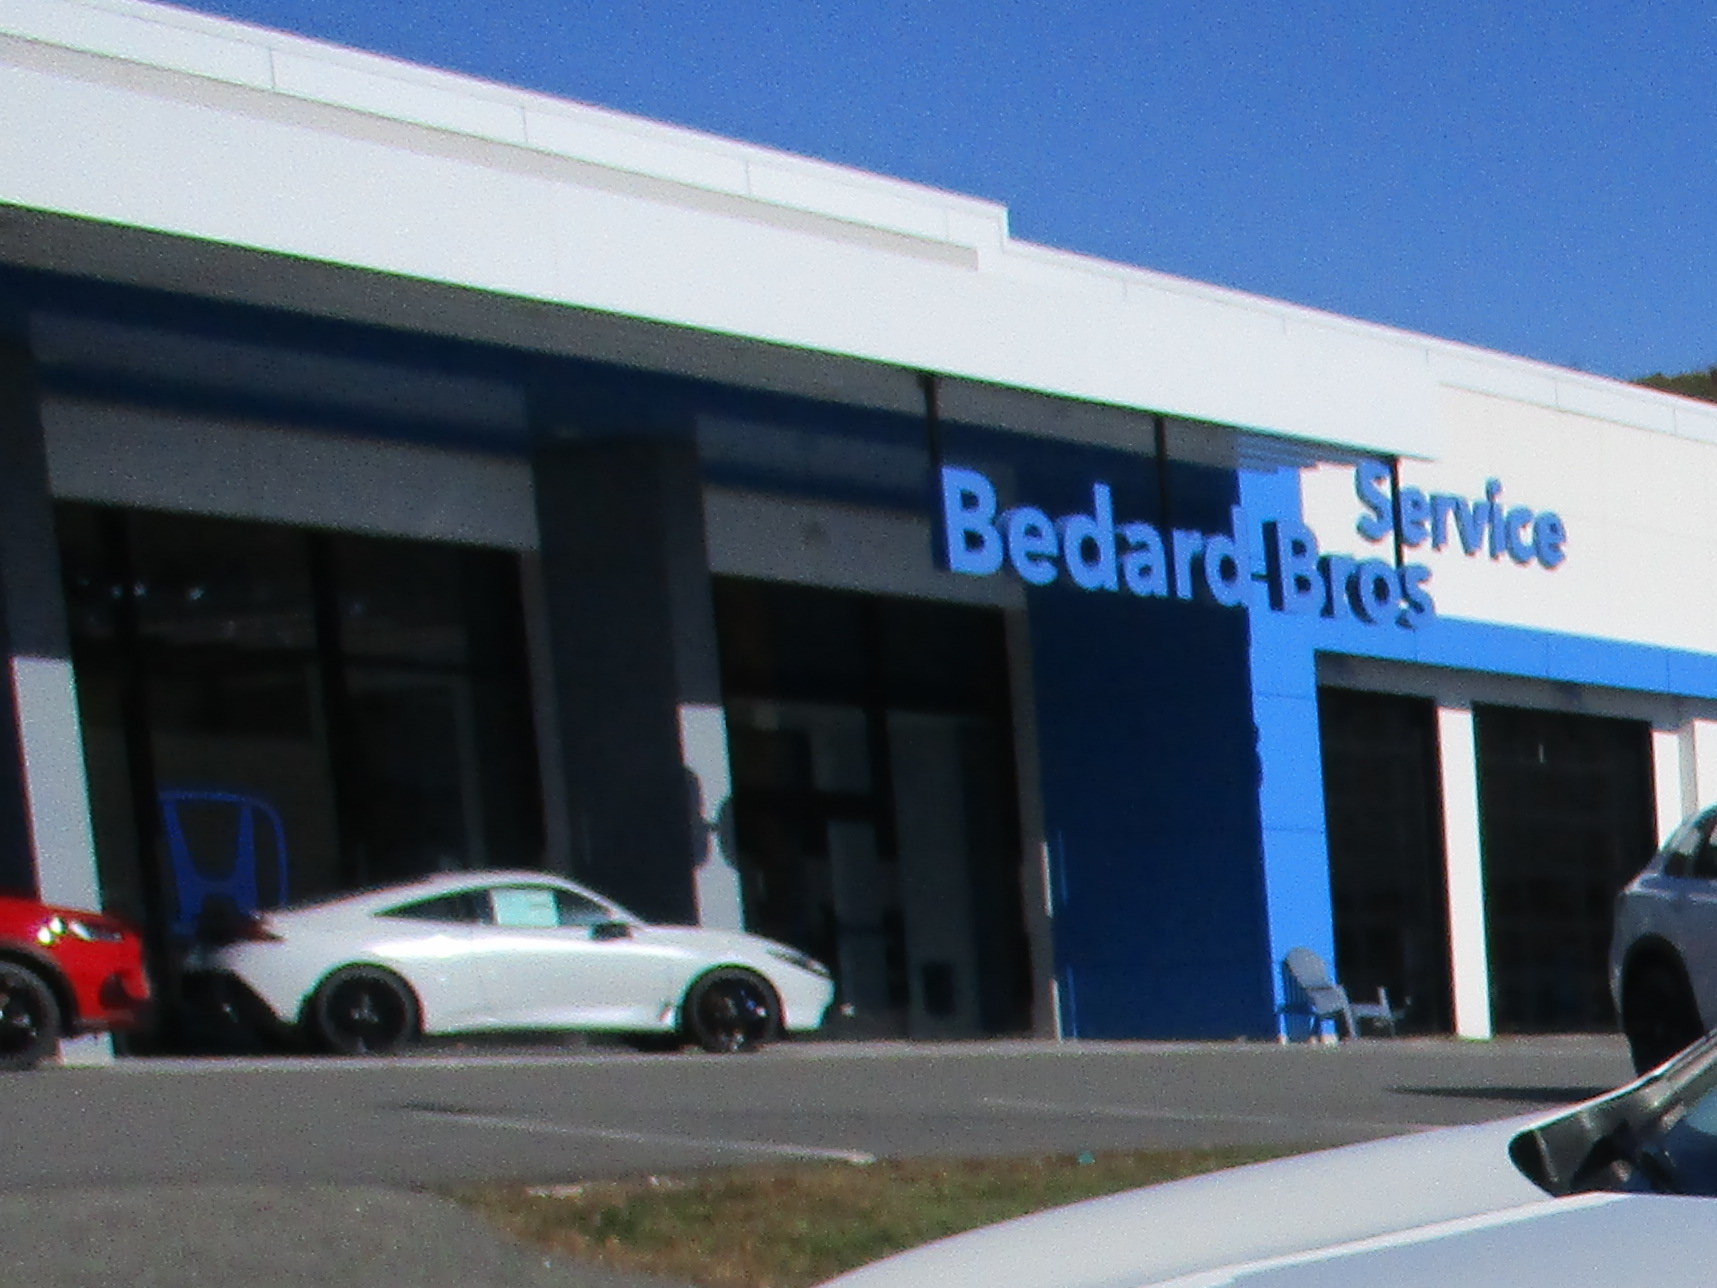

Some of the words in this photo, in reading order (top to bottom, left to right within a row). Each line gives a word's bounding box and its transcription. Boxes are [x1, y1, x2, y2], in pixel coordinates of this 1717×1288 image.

[939, 465, 1253, 607] Bedard
[1278, 517, 1437, 625] Bros
[1354, 460, 1567, 570] Service
